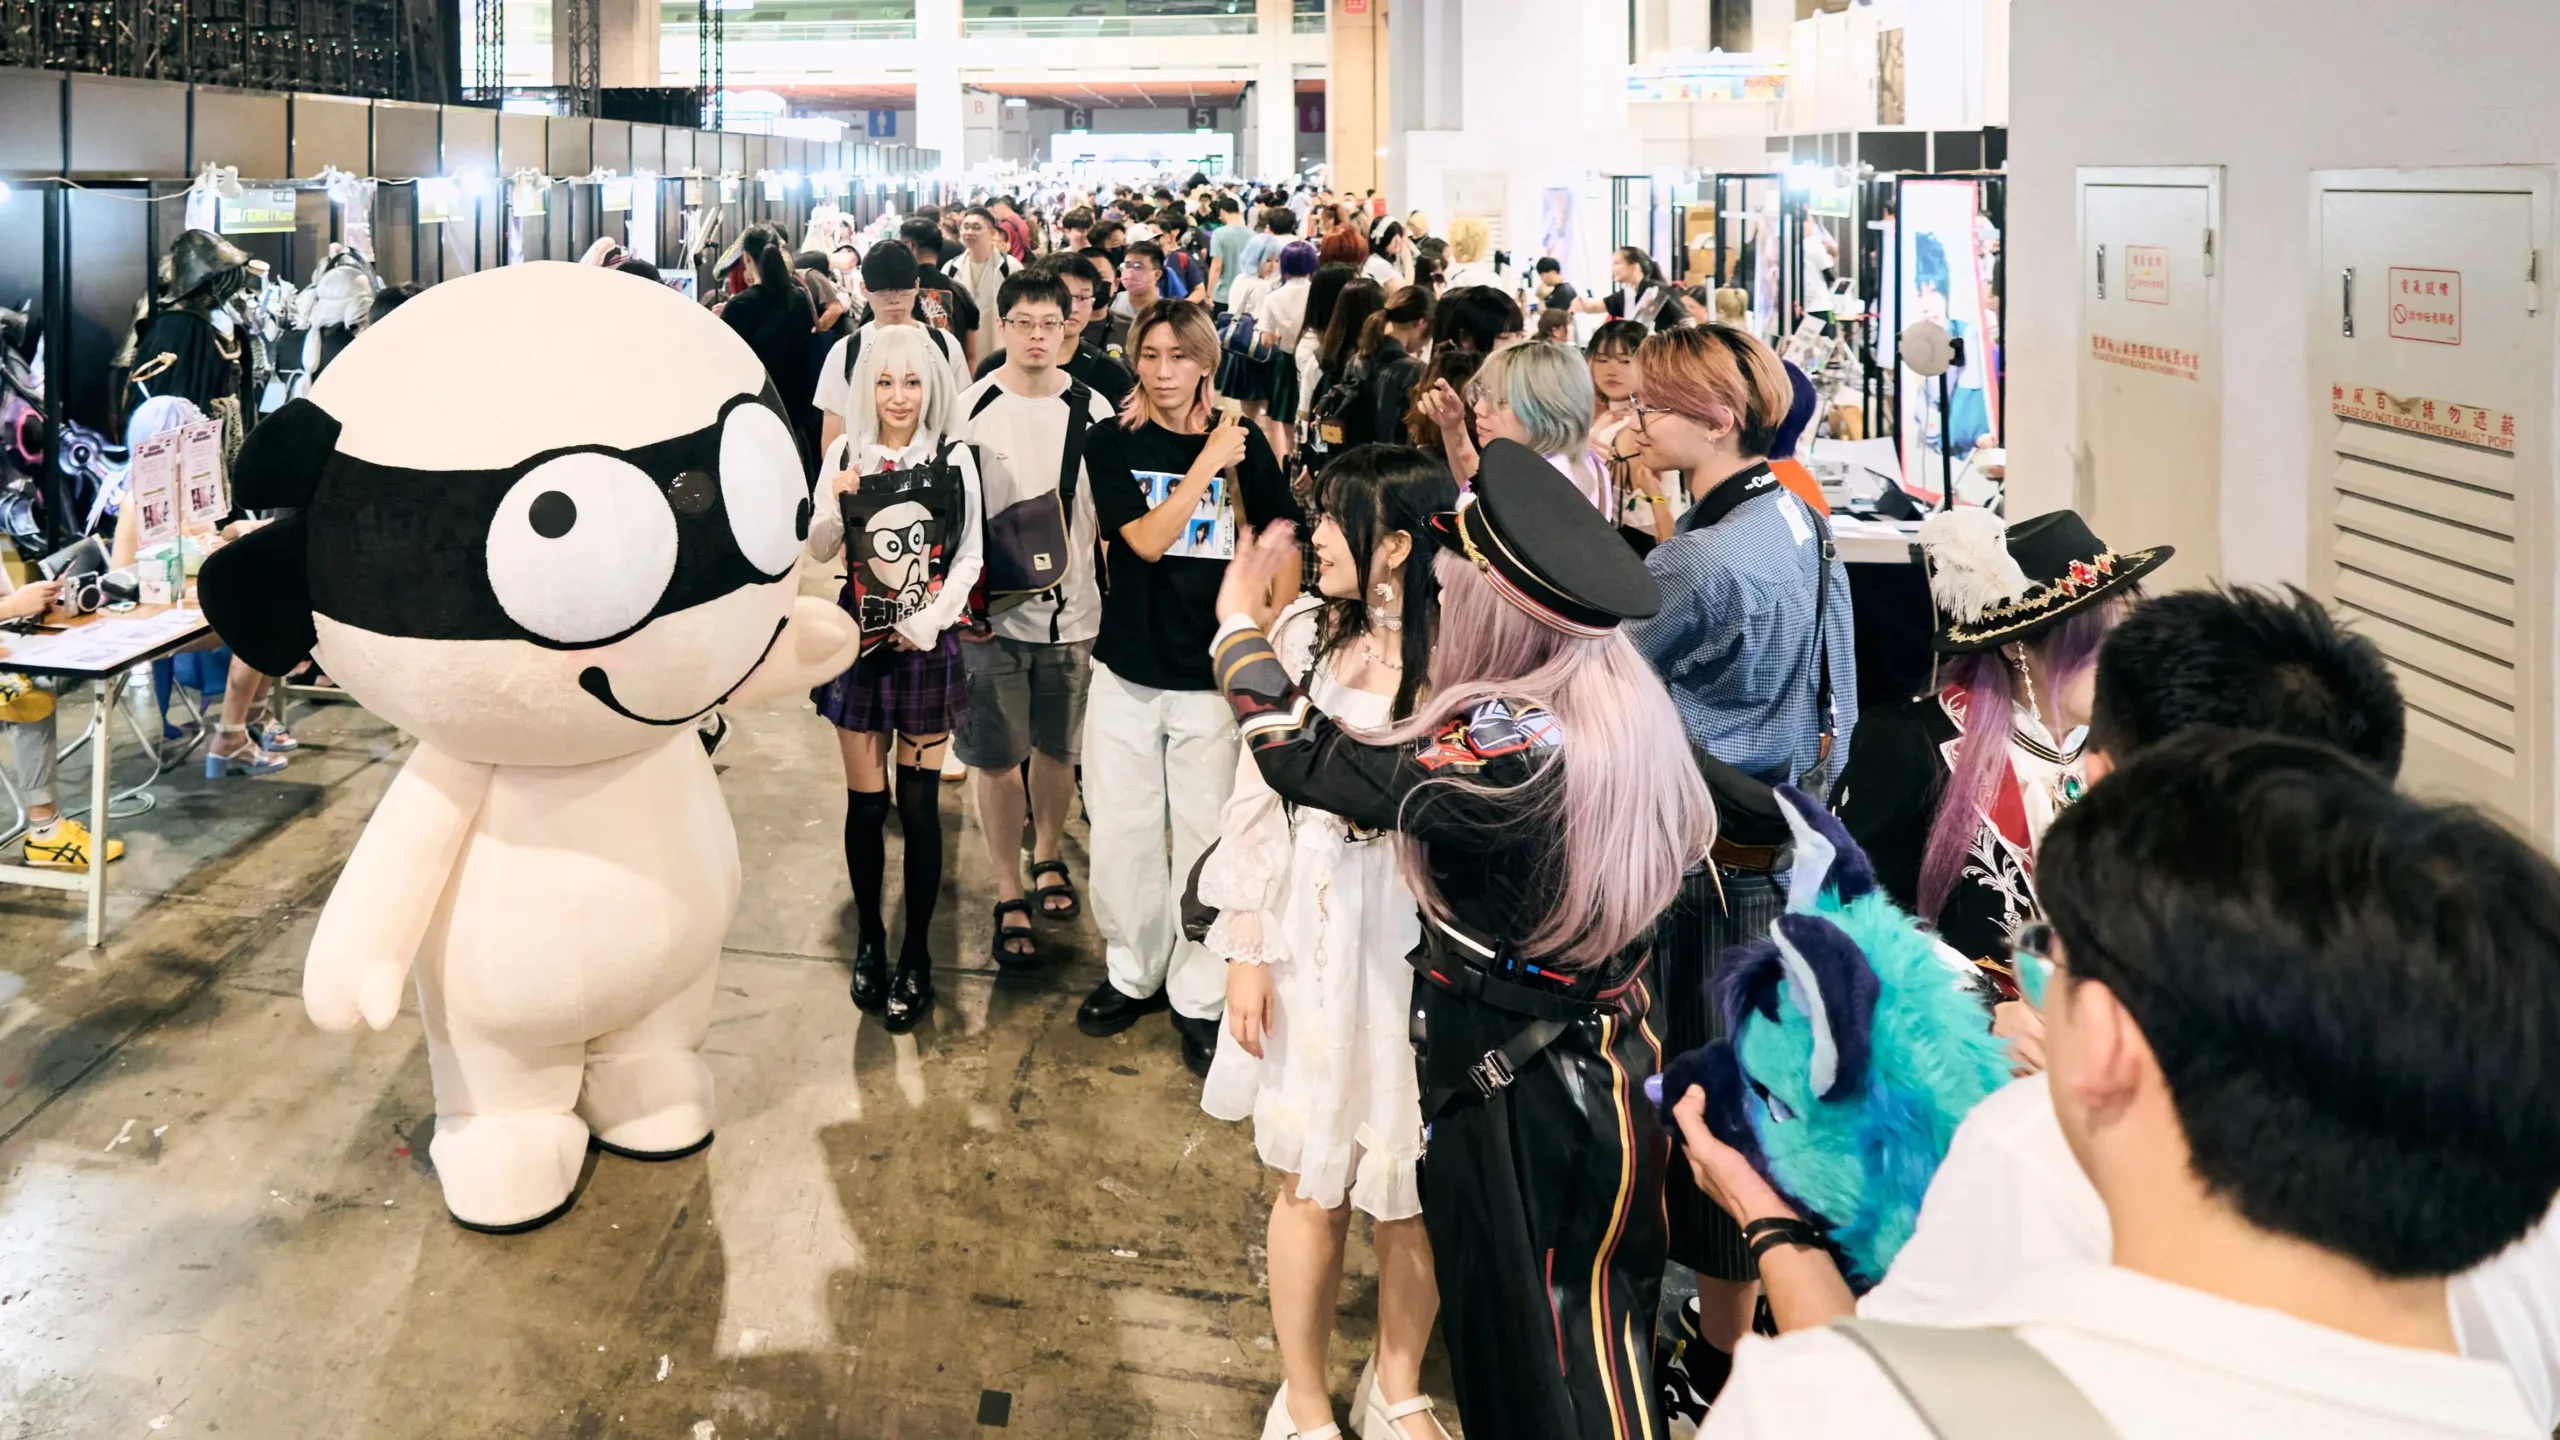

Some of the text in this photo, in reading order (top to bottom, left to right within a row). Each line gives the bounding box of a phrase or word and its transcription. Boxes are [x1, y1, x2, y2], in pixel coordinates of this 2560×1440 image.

[974, 100, 985, 114] B
[1071, 108, 1087, 128] 6
[1195, 108, 1210, 128] 5
[2332, 384, 2515, 437] 抽風百請勿遮蔽
[2332, 402, 2513, 450] PLEASE DO NOT BLOCK THIS EXHAUST PORT
